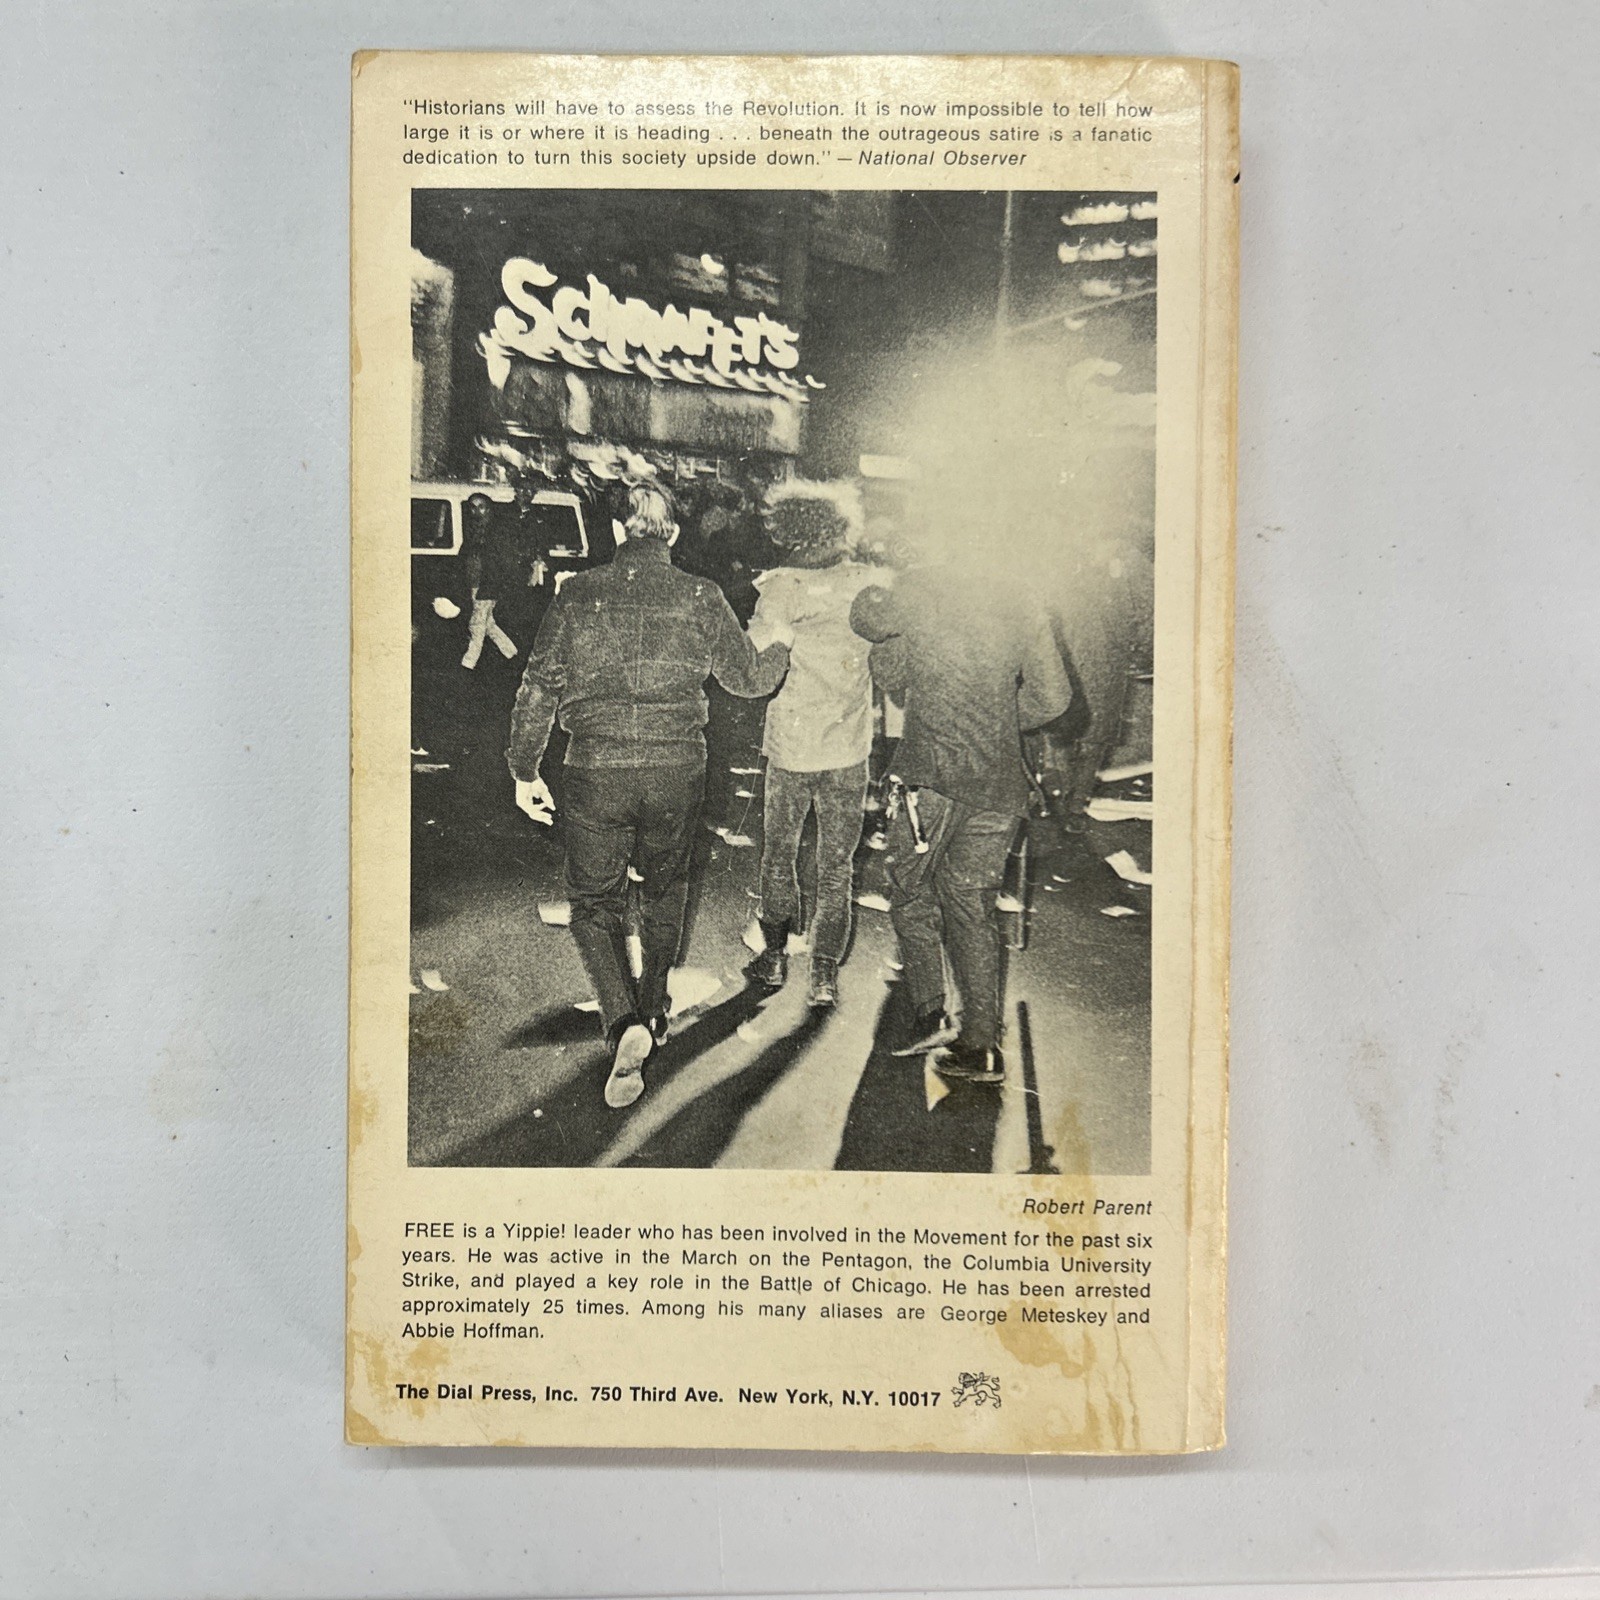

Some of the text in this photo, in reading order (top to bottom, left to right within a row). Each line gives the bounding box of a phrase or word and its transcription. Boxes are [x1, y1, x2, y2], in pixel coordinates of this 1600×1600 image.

[515, 100, 545, 116] will
[556, 101, 598, 116] have
[608, 102, 625, 116] to
[635, 103, 696, 117] assess
[705, 101, 733, 116] the
[743, 101, 845, 117] Revolution.
[855, 102, 867, 116] It
[876, 101, 890, 116] is
[900, 104, 936, 116] now
[946, 101, 1043, 119] impossible
[1053, 103, 1070, 117] to
[1079, 101, 1106, 117] tell
[1116, 102, 1153, 117] how
[403, 124, 449, 141] large
[459, 125, 470, 140] it
[479, 124, 493, 140] is
[503, 129, 521, 140] or
[530, 125, 585, 140] where
[594, 125, 605, 141] it
[615, 125, 628, 141] is
[637, 125, 710, 143] heading
[760, 125, 832, 142] beneath
[842, 126, 869, 141] the
[879, 127, 980, 144] outrageous
[988, 126, 1040, 142] satire
[1049, 127, 1063, 142] is
[1072, 129, 1082, 142] a
[1091, 126, 1152, 142] fanatic
[403, 150, 497, 165] dedication
[507, 151, 524, 165] to
[535, 151, 570, 165] turn
[580, 150, 612, 165] this
[622, 150, 687, 168] society
[697, 150, 757, 169] upside
[858, 150, 935, 166] National
[943, 150, 1027, 166] Observer
[1023, 1198, 1152, 1215] Robert Parent
[405, 1222, 1152, 1251] FREE is a Yippie! leader who has been involved in the Movement for the past six
[402, 1248, 1151, 1277] years. He was active in the March on the Pentagon, the Columbia University
[402, 1272, 1150, 1298] Strike, and played a key role in the Battle of Chicago. He has been arrested
[402, 1297, 1150, 1327] approximately 25 times. Among his many aliases are George Meteskey and
[402, 1322, 543, 1338] Abbie Hoffman.
[395, 1384, 941, 1407] The Dial Press, Inc. 750 Third Ave. New York, N.Y. 10017
